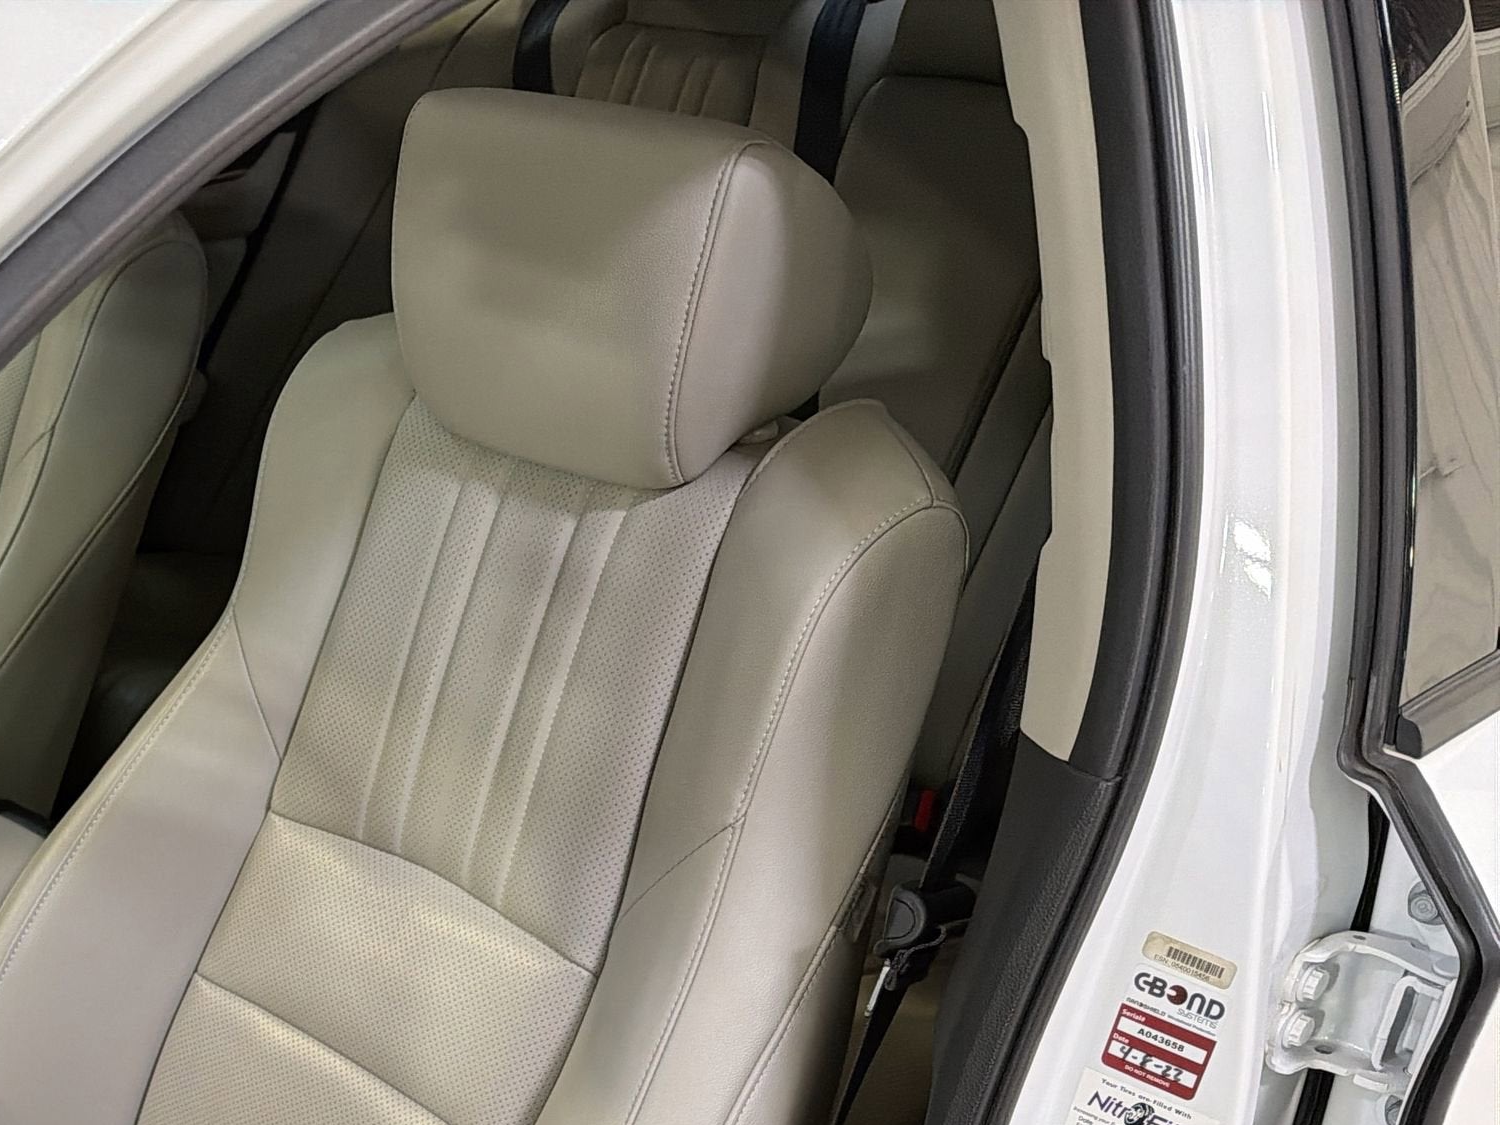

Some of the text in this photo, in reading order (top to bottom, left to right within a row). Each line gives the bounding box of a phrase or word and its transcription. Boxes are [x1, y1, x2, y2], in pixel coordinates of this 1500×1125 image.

[1112, 1032, 1129, 1044] Date
[1137, 1028, 1185, 1052] A043658
[1133, 1069, 1146, 1077] NOT
[1146, 1074, 1170, 1087] REMOVE
[1102, 1078, 1118, 1089] Your
[1120, 1086, 1136, 1096] Tires
[1152, 1099, 1173, 1112] Filled
[1175, 1109, 1192, 1119] With
[1078, 1115, 1094, 1125] Date
